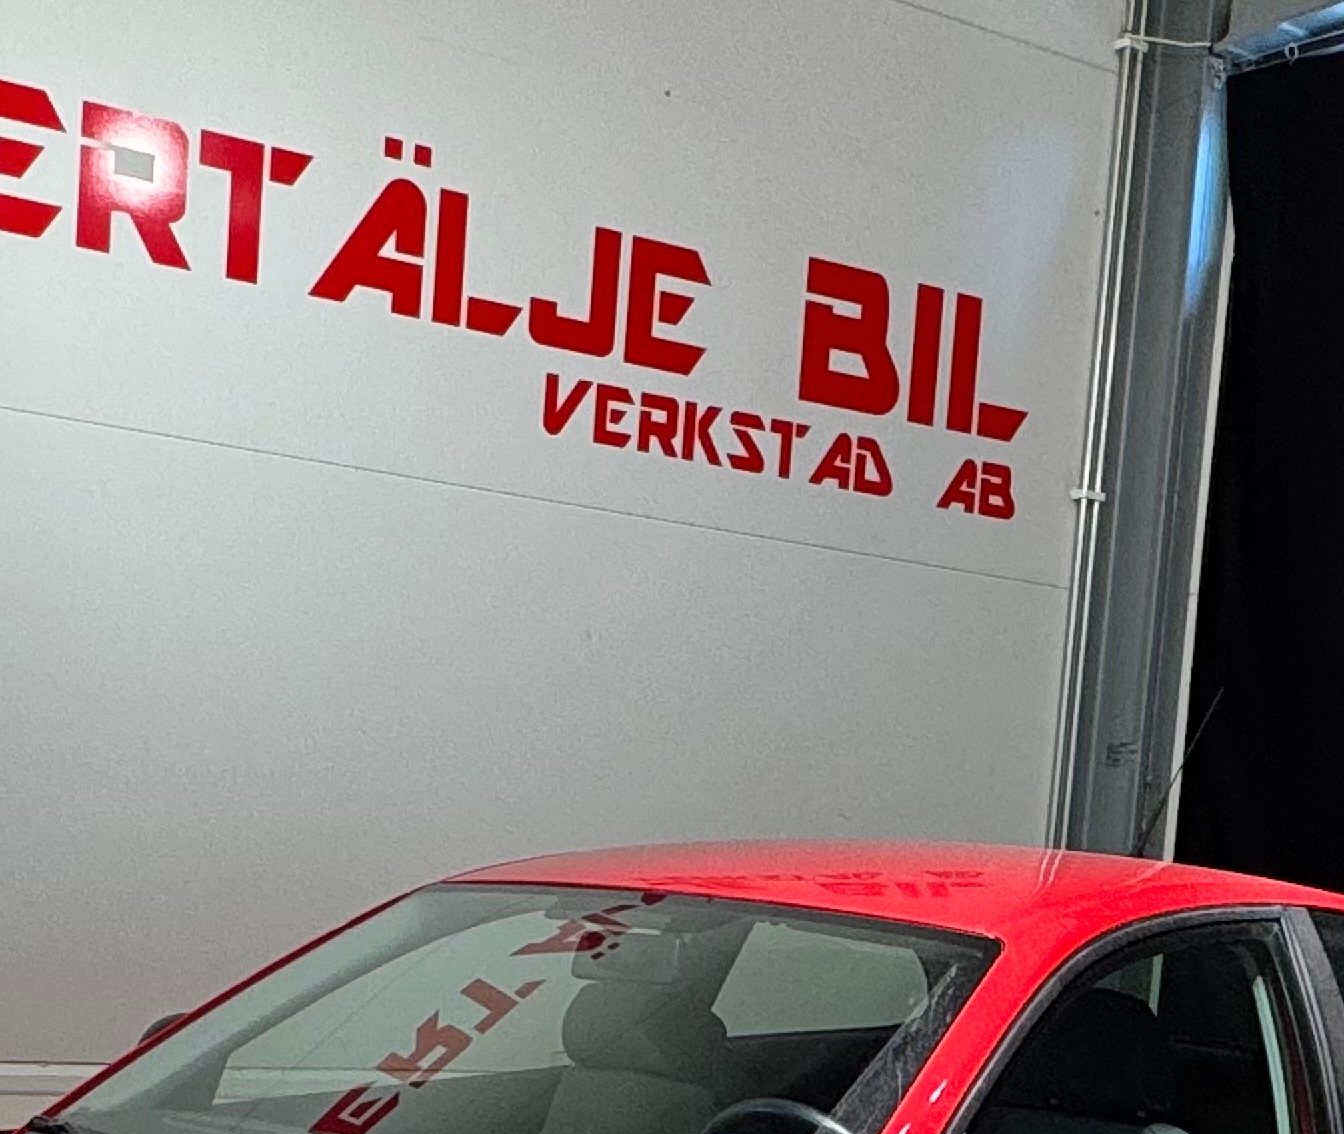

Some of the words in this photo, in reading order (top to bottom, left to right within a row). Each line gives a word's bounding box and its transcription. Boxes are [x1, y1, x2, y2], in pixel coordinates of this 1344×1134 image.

[798, 256, 1029, 442] BIL
[542, 373, 894, 498] VERKSTAD
[937, 458, 1016, 520] AB
